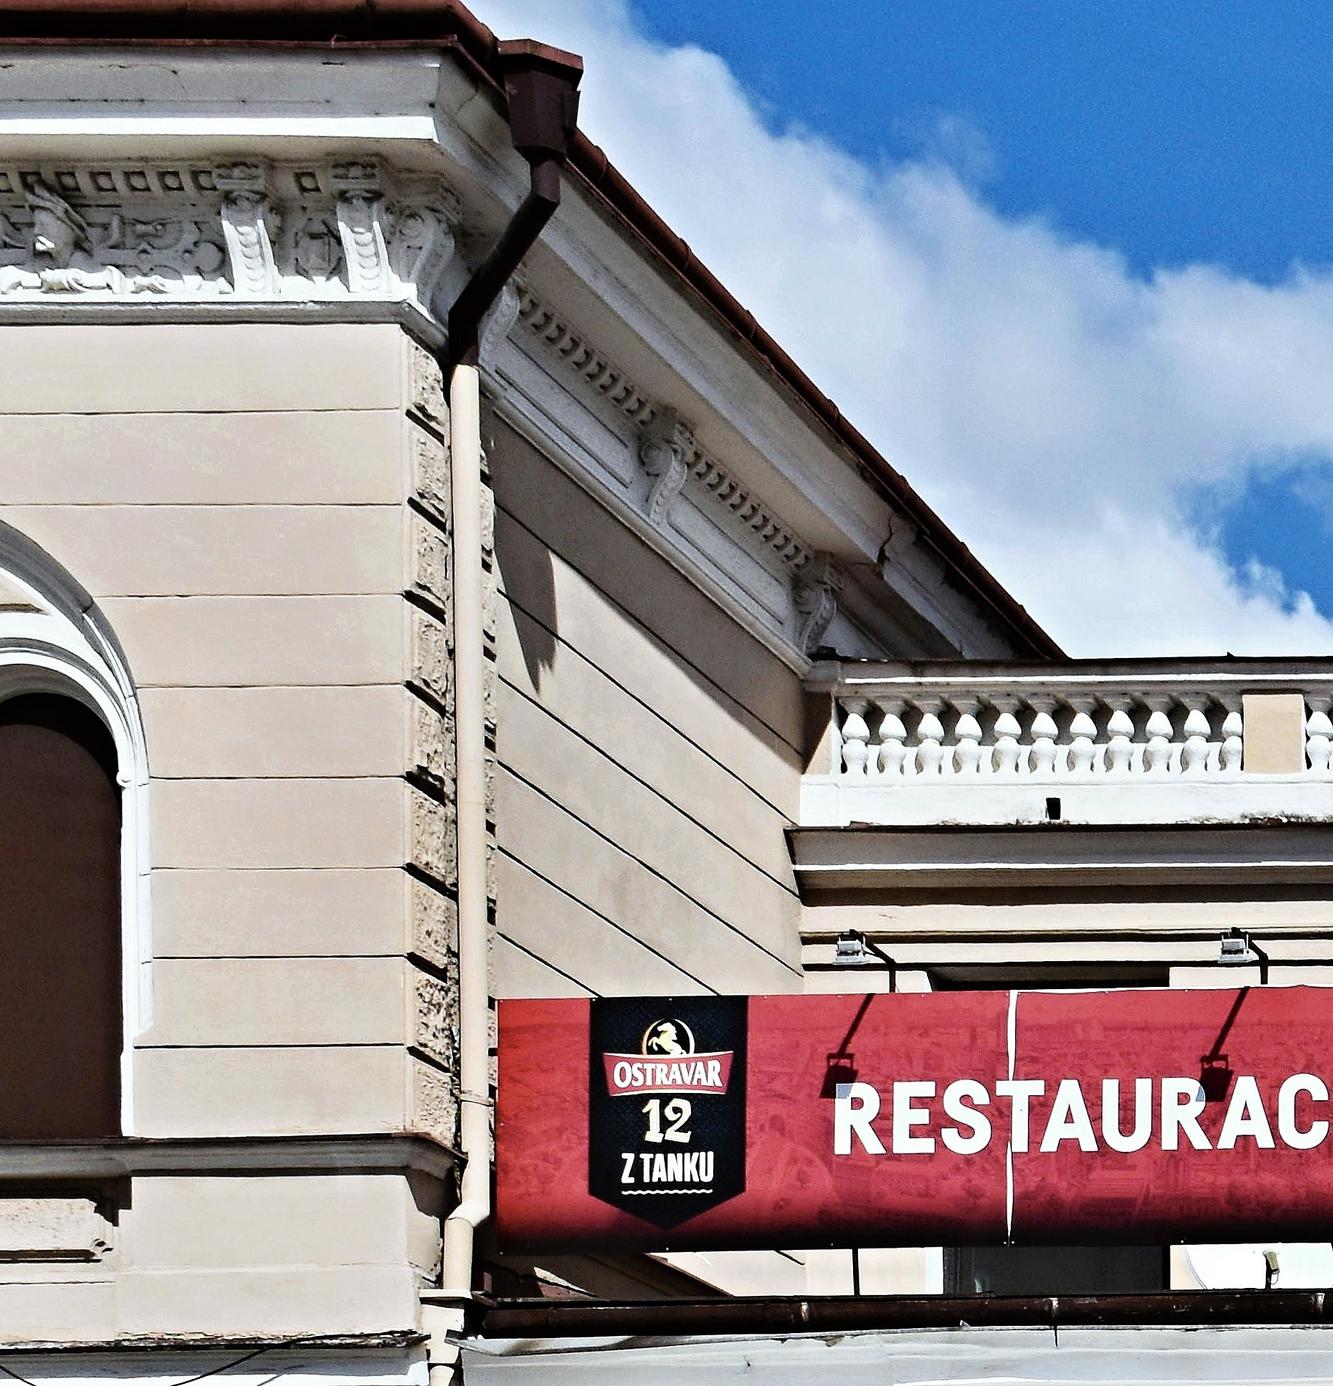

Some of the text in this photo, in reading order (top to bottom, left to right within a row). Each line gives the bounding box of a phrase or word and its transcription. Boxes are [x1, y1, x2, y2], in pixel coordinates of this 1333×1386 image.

[613, 1059, 723, 1088] OSTRAVAR
[641, 1097, 692, 1143] 12
[620, 1151, 714, 1184] Z TANKU
